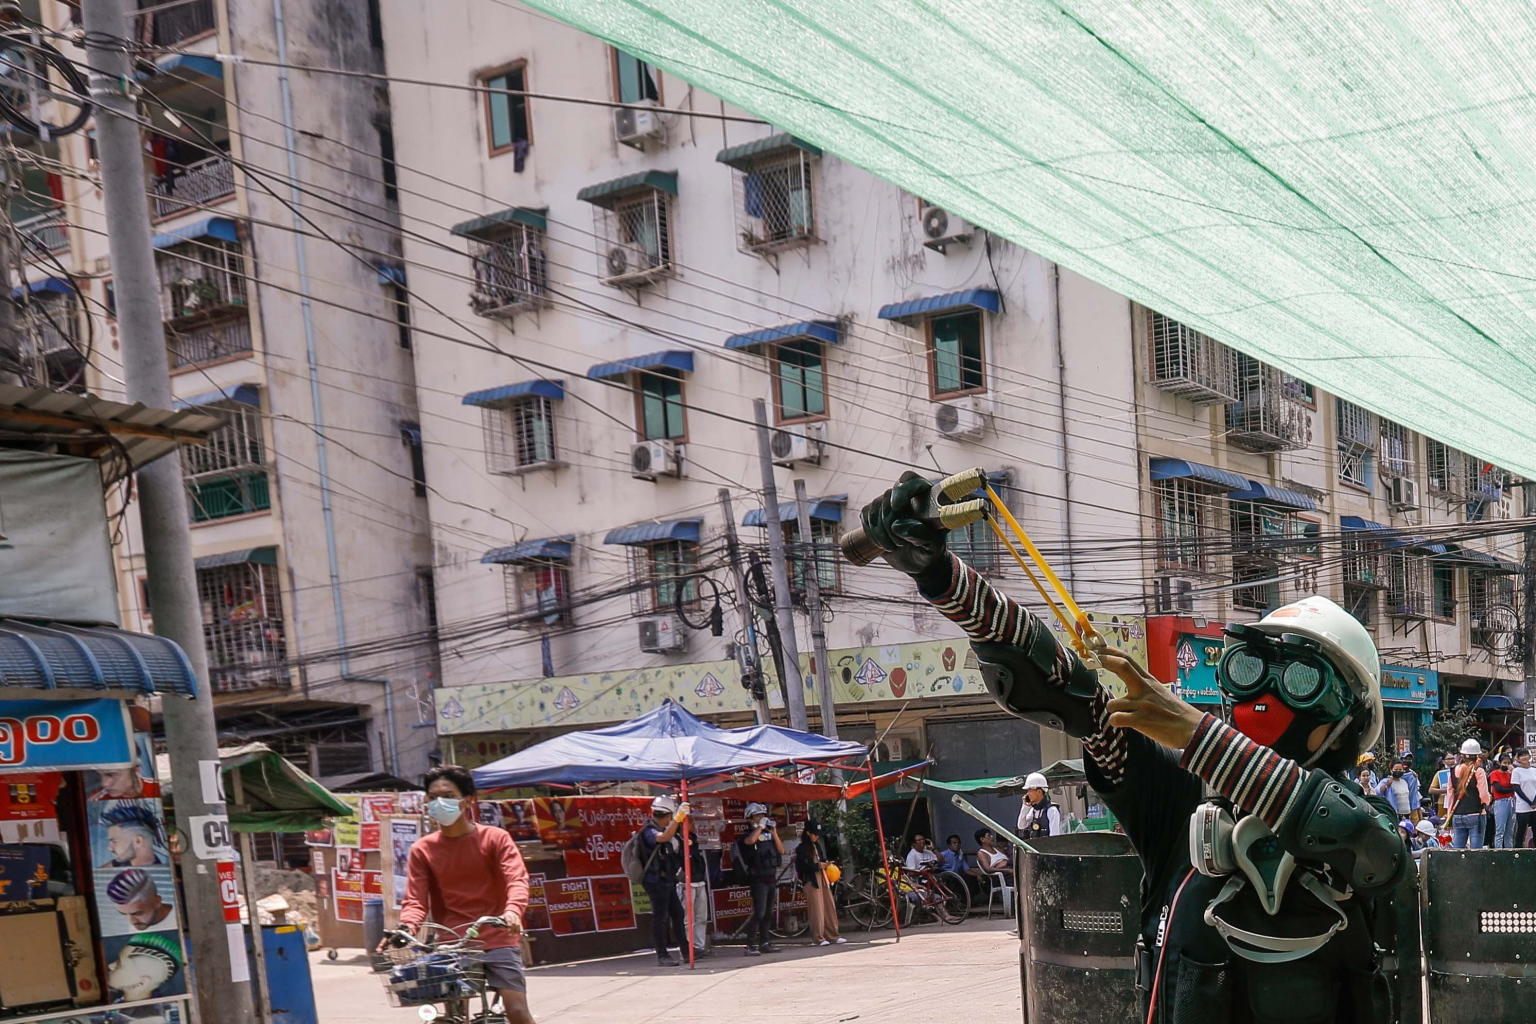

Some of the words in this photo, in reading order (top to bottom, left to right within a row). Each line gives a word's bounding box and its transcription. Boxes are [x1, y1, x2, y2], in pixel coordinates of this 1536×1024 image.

[203, 821, 232, 848] CD
[220, 879, 238, 903] C
[561, 881, 588, 892] FIGHT
[729, 890, 751, 899] FIGHT
[549, 901, 591, 911] DEMOCRACY
[716, 906, 753, 918] DEMOCRACY
